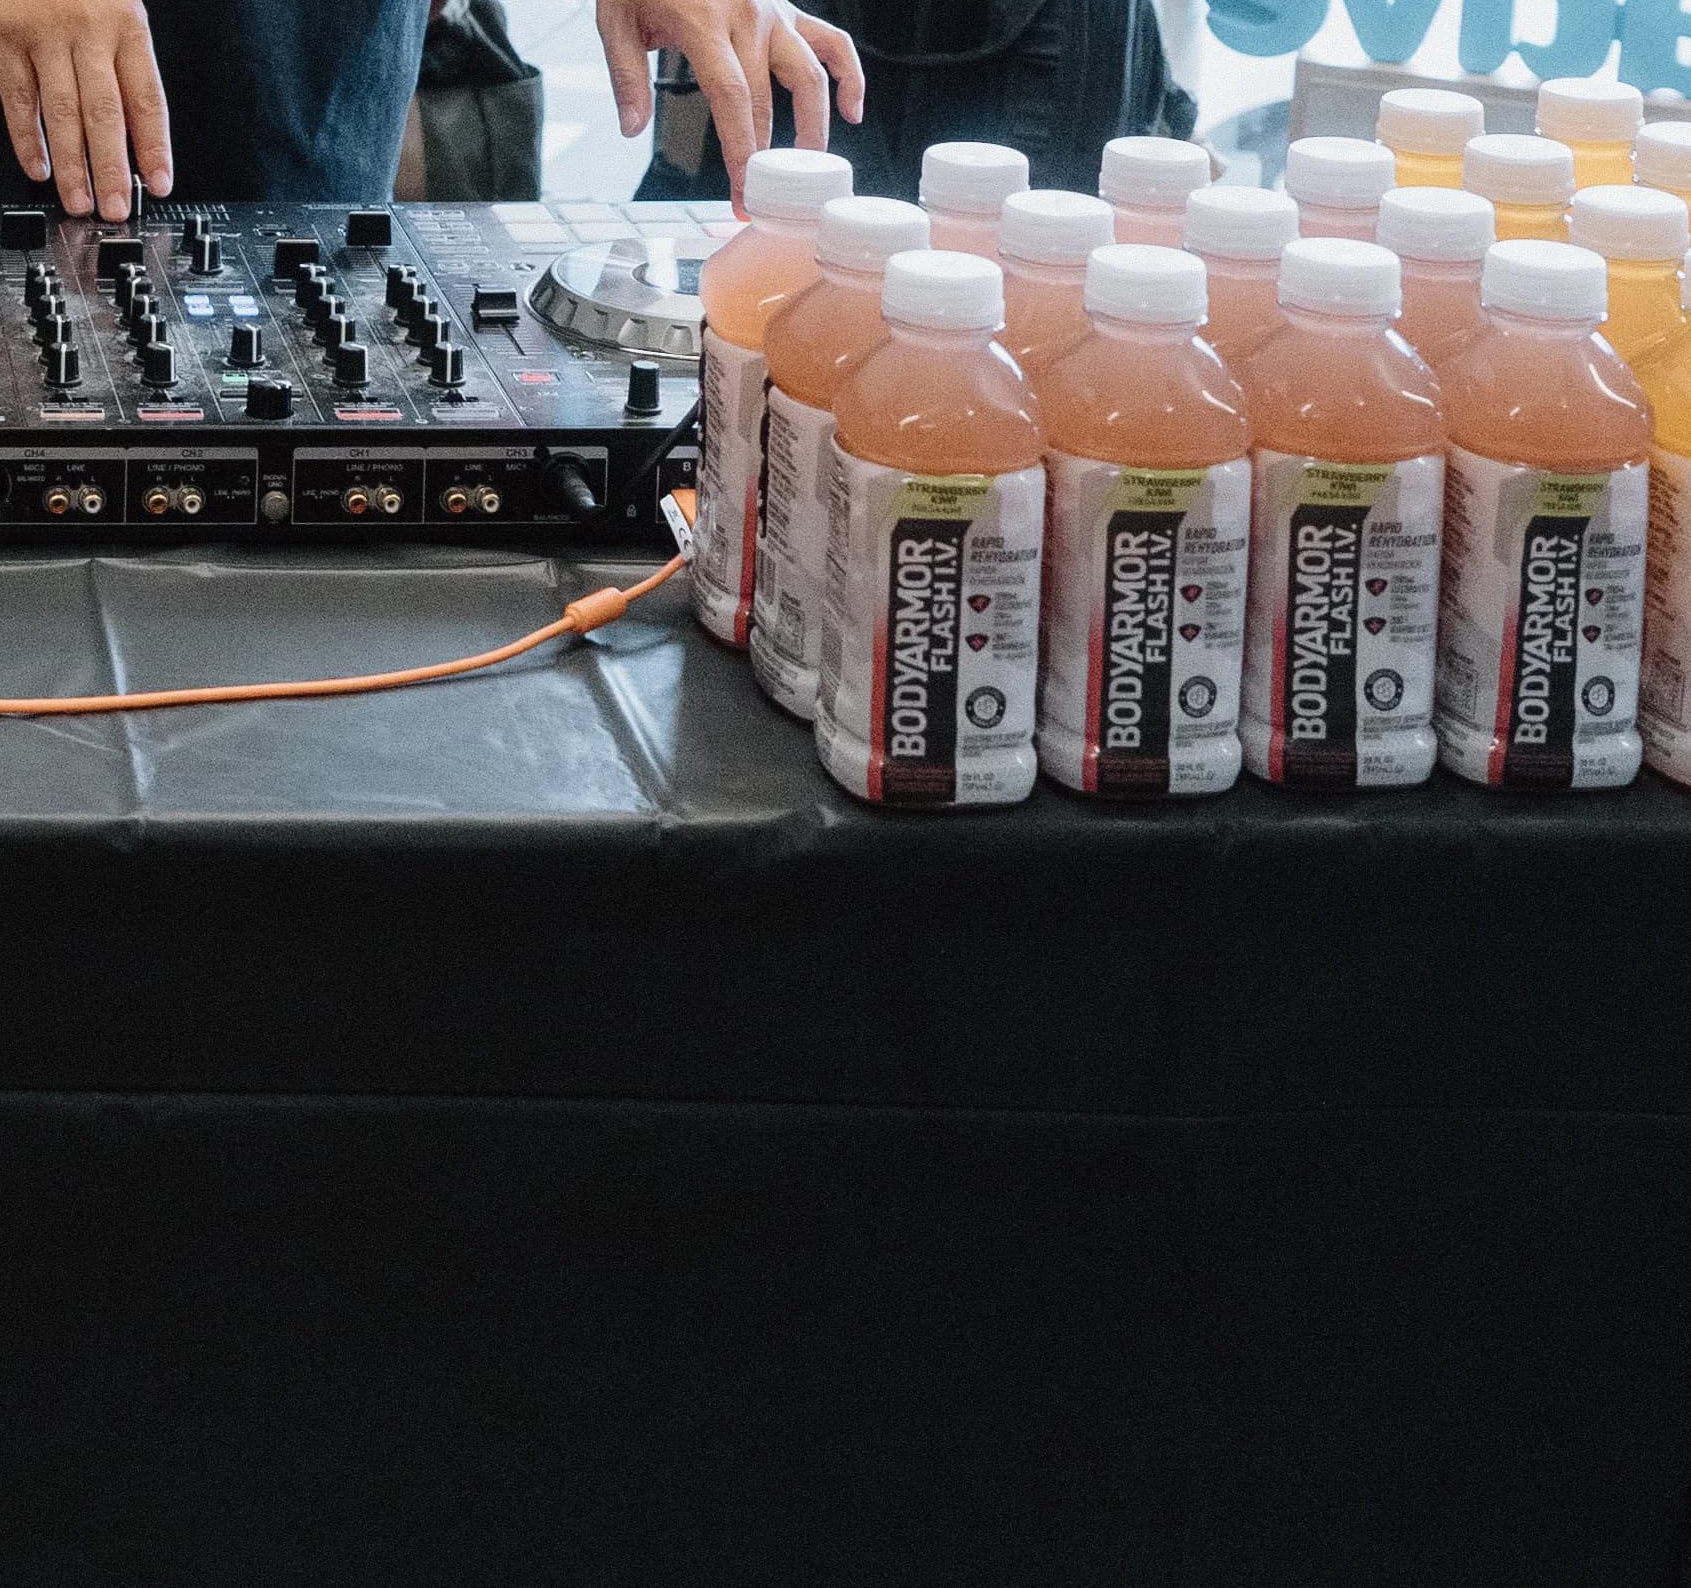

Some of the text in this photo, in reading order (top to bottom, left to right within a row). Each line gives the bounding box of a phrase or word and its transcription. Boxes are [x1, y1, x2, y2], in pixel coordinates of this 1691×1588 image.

[24, 448, 46, 458] CH4
[349, 448, 371, 458] CH1
[67, 463, 86, 472] LINE
[147, 463, 167, 472] LINE
[174, 463, 206, 472] PHONO
[346, 463, 366, 472] LINE
[372, 463, 404, 472] PHONO
[464, 463, 484, 472] LINE
[1305, 467, 1388, 482] STRAWBERRY
[906, 481, 988, 496] STRAWBERRY
[1123, 476, 1203, 487] STRAWBERRY
[1541, 481, 1604, 493] STRAWBERRY
[1185, 527, 1218, 540] RAPID
[1369, 522, 1403, 535] RAPID
[970, 536, 1005, 549] RAPID
[1183, 537, 1246, 555] REHYDRATION
[1368, 533, 1437, 549] REHYDRATION
[933, 537, 958, 575] I.V.
[969, 547, 1039, 564] REHYDRATION
[1145, 528, 1173, 664] FLASH I.V.
[1329, 523, 1358, 656] FLASH I.V.
[1552, 533, 1579, 663] FLASH I.V.
[930, 581, 957, 672] FLASH
[1291, 524, 1334, 740] BODYARMOR
[1106, 530, 1150, 749] BODYARMOR
[1513, 535, 1559, 745] BODYARMOR
[891, 538, 934, 757] BODYARMOR
